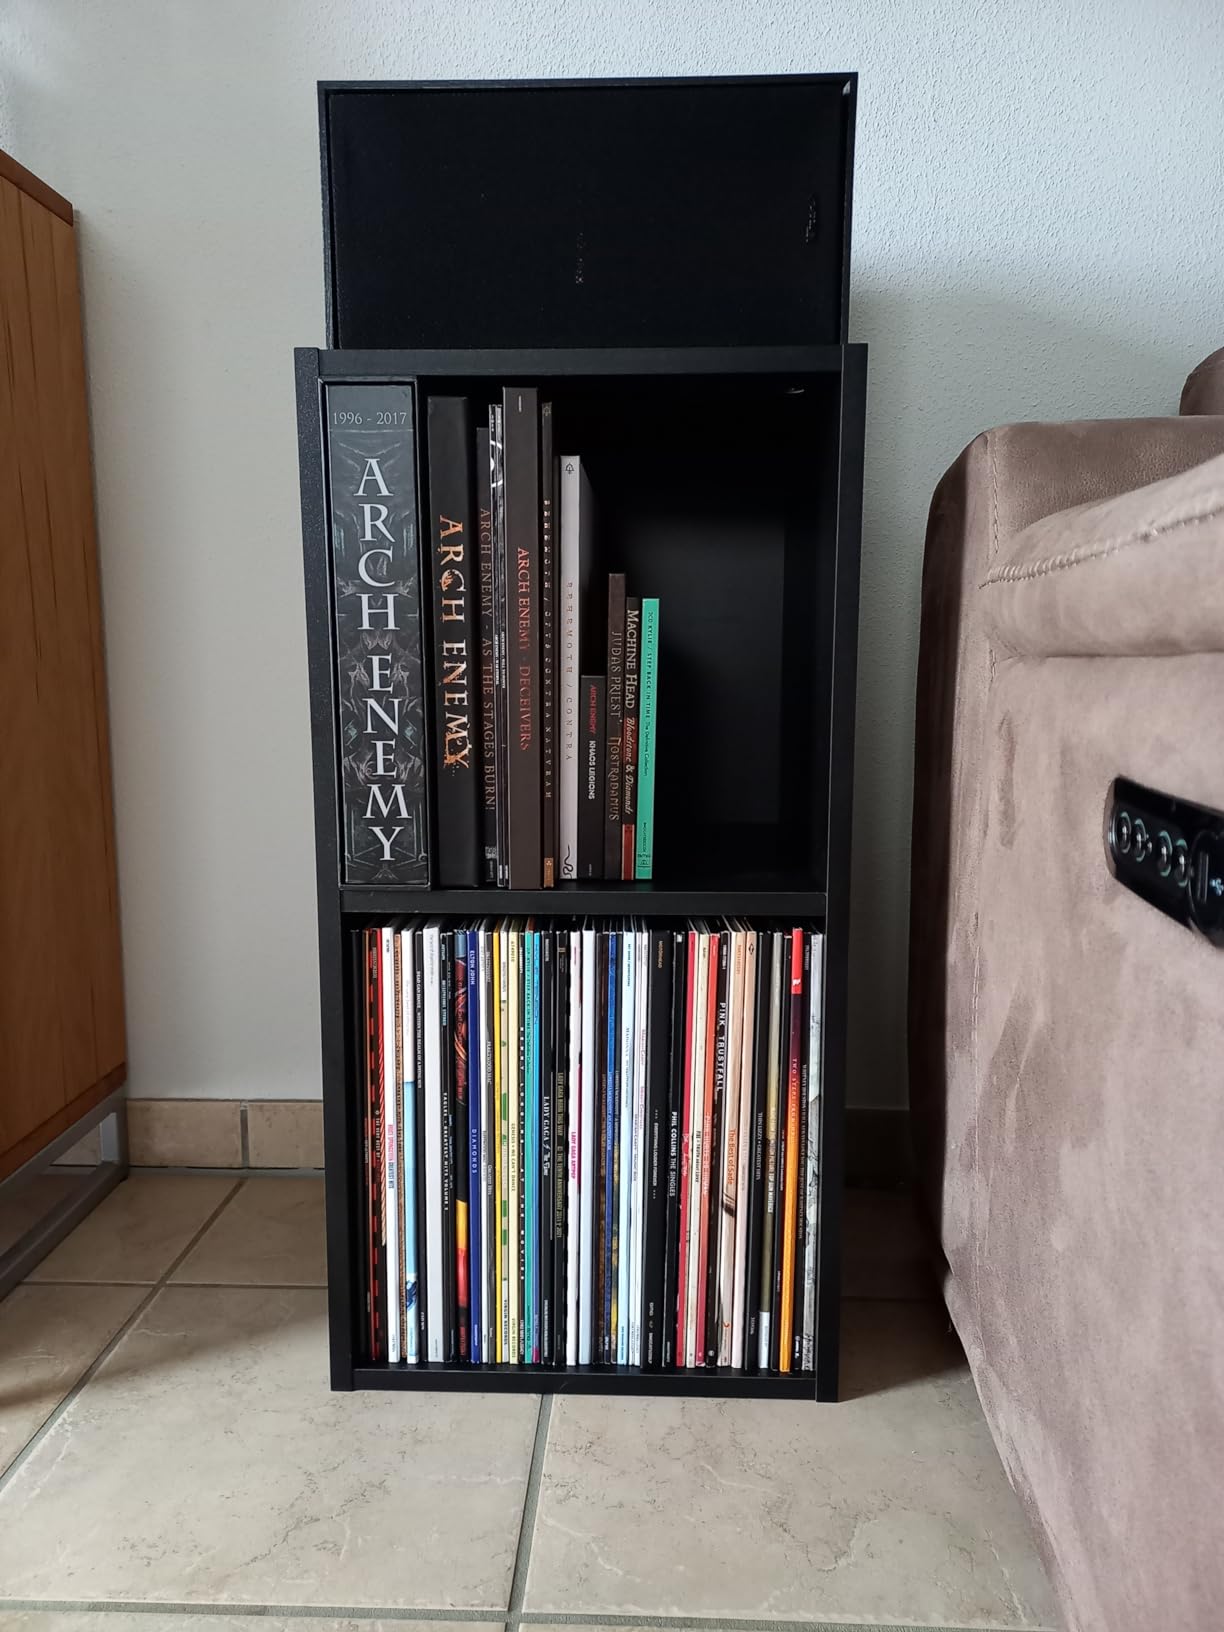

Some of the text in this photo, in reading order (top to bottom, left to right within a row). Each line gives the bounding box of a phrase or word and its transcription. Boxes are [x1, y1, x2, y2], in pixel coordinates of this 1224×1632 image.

[332, 411, 363, 425] 1996
[376, 411, 407, 425] 2017
[353, 457, 412, 862] ARCH ENEMY
[440, 514, 472, 770] ARCH ENEMY
[480, 508, 496, 810] ARCH ENEMY AS THE STAGES BURN!
[518, 547, 532, 751] ARCH ENEMY DECEIVERS
[609, 631, 622, 718] JUDAS PRIEST
[625, 609, 639, 709] MACHINE HEAD
[646, 692, 652, 700] IN
[588, 767, 596, 800] LEGIONS
[608, 736, 622, 821] NOSTRADAMUS
[625, 717, 635, 814] Bloodstone & Diamonds
[717, 1036, 725, 1092] TRUSTFALL
[728, 1143, 736, 1158] Best
[728, 1159, 735, 1167] of
